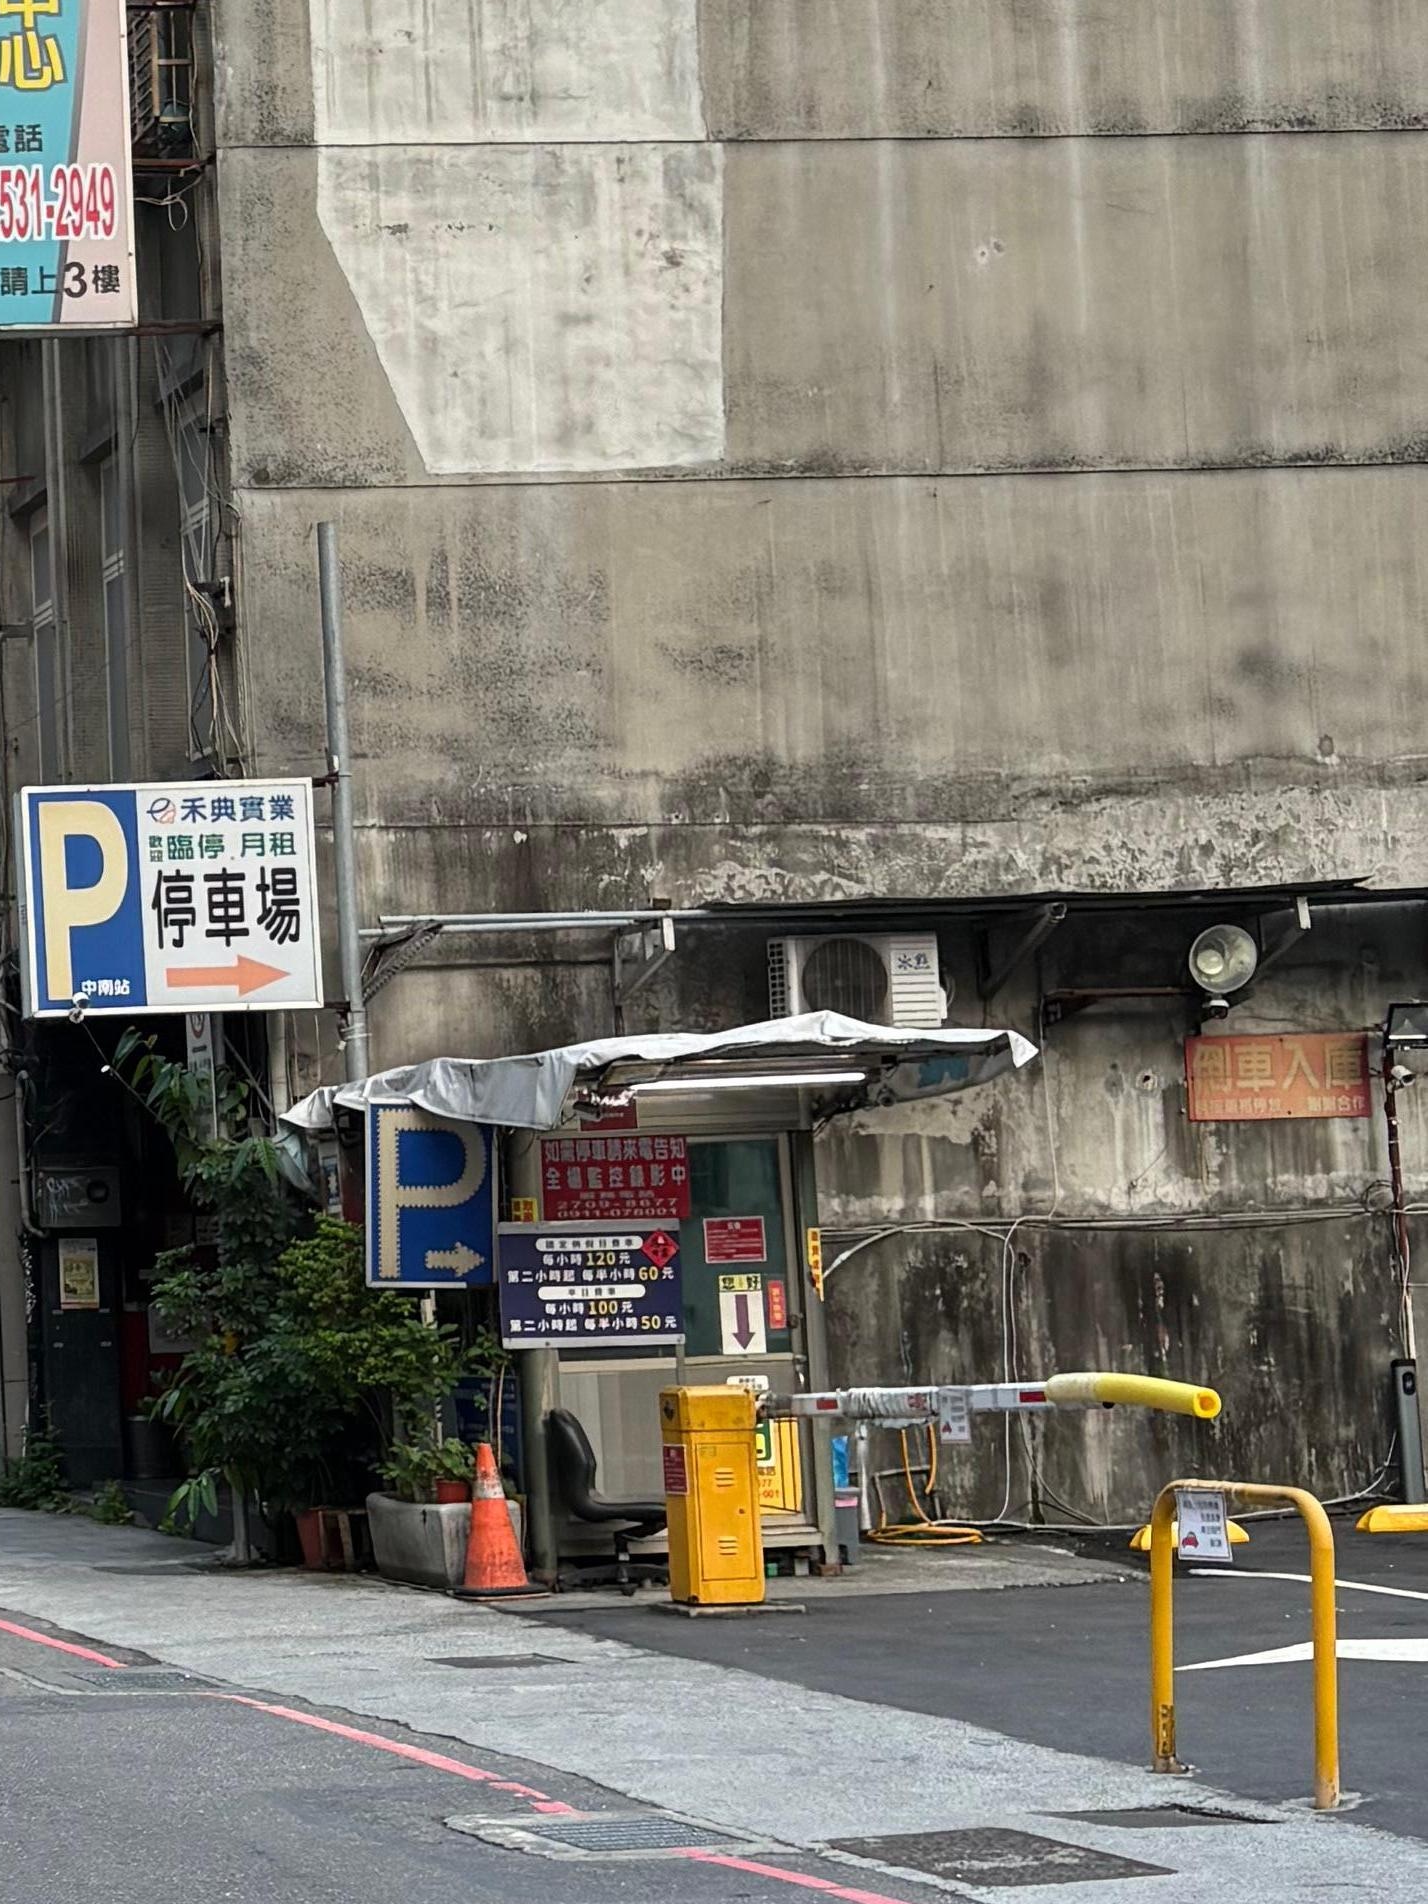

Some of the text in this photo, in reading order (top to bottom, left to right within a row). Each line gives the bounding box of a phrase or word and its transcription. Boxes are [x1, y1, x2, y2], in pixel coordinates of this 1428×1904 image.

[0, 261, 120, 298] 請上3樓
[181, 794, 295, 823] 禾典實業
[38, 801, 128, 1000] P
[151, 866, 301, 949] 停車場
[378, 1108, 486, 1278] P
[543, 1253, 630, 1266] 每小時 120 元
[638, 1267, 659, 1280] 60
[662, 1267, 675, 1280] 元
[545, 1302, 633, 1315] 每小時 100 元
[641, 1316, 661, 1329] 50
[664, 1316, 677, 1328] 元
